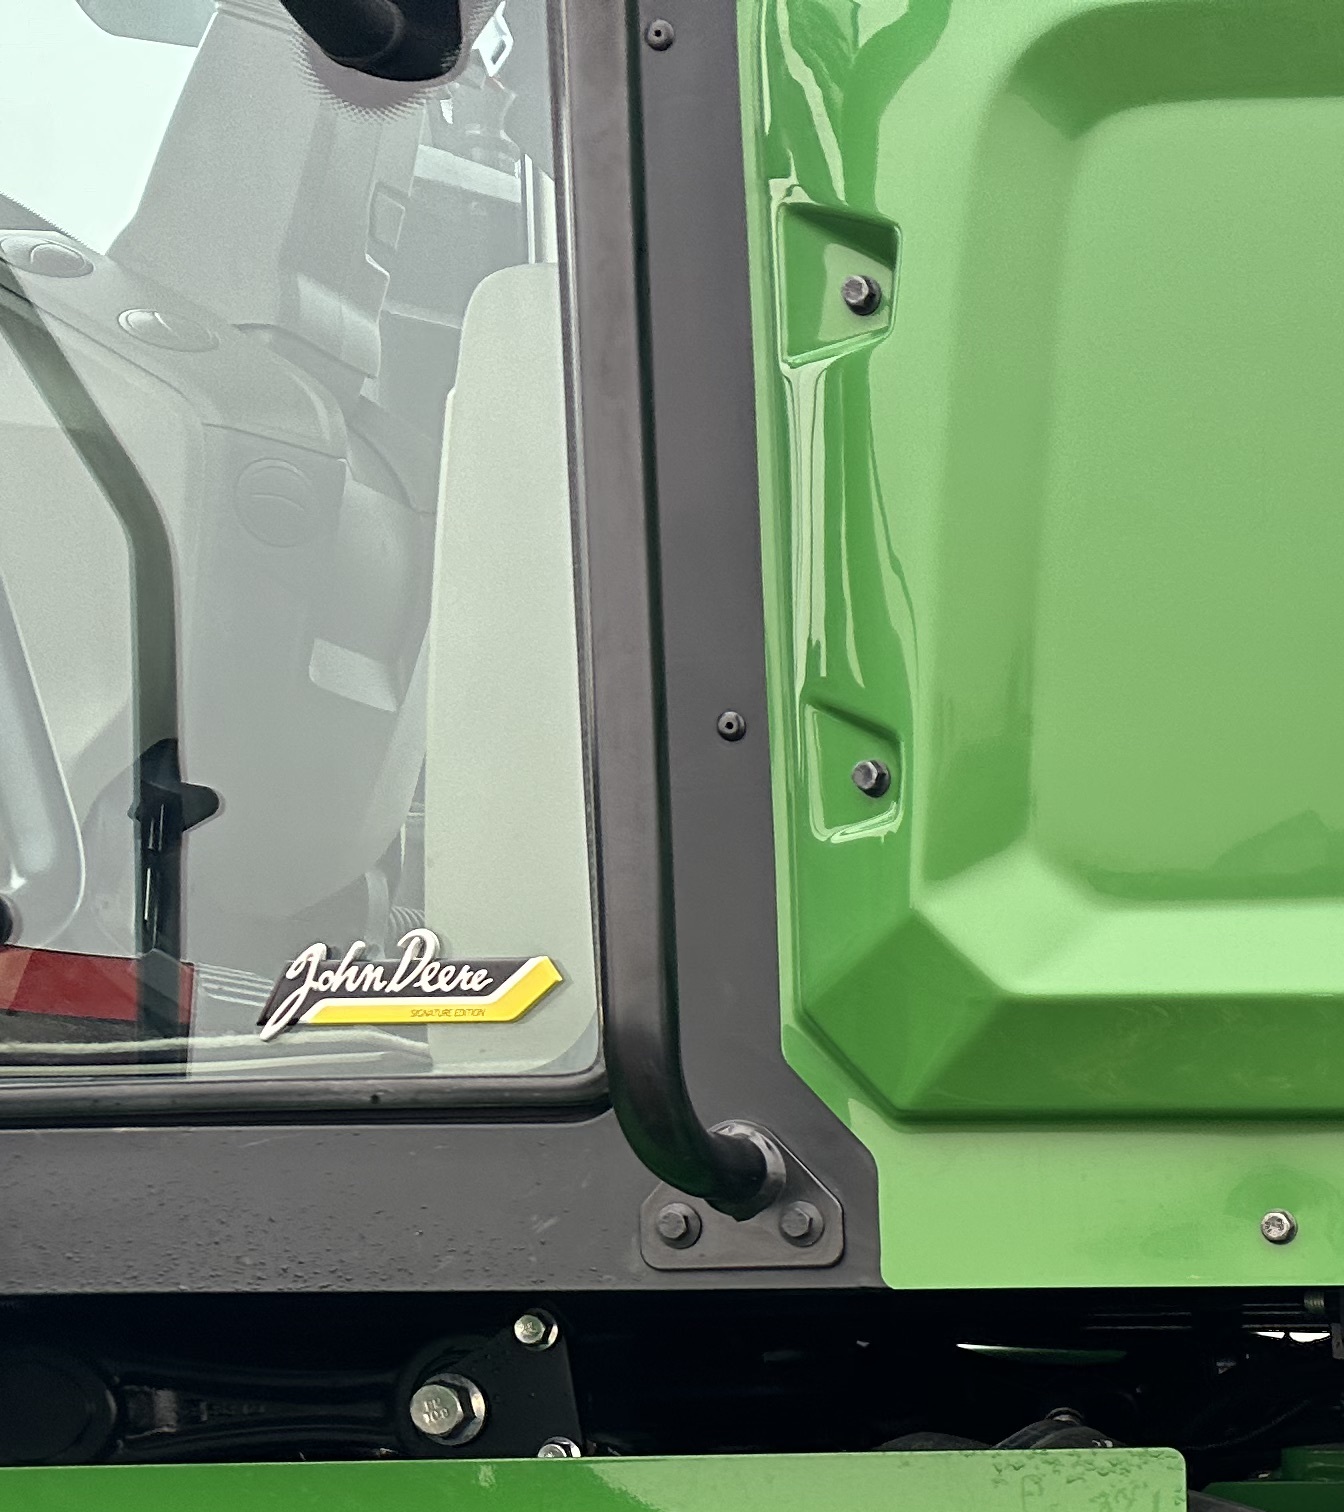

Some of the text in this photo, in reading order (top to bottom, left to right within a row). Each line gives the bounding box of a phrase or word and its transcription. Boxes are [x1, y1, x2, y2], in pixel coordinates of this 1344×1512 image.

[259, 928, 494, 1041] John Deere
[454, 1008, 486, 1017] EDITION
